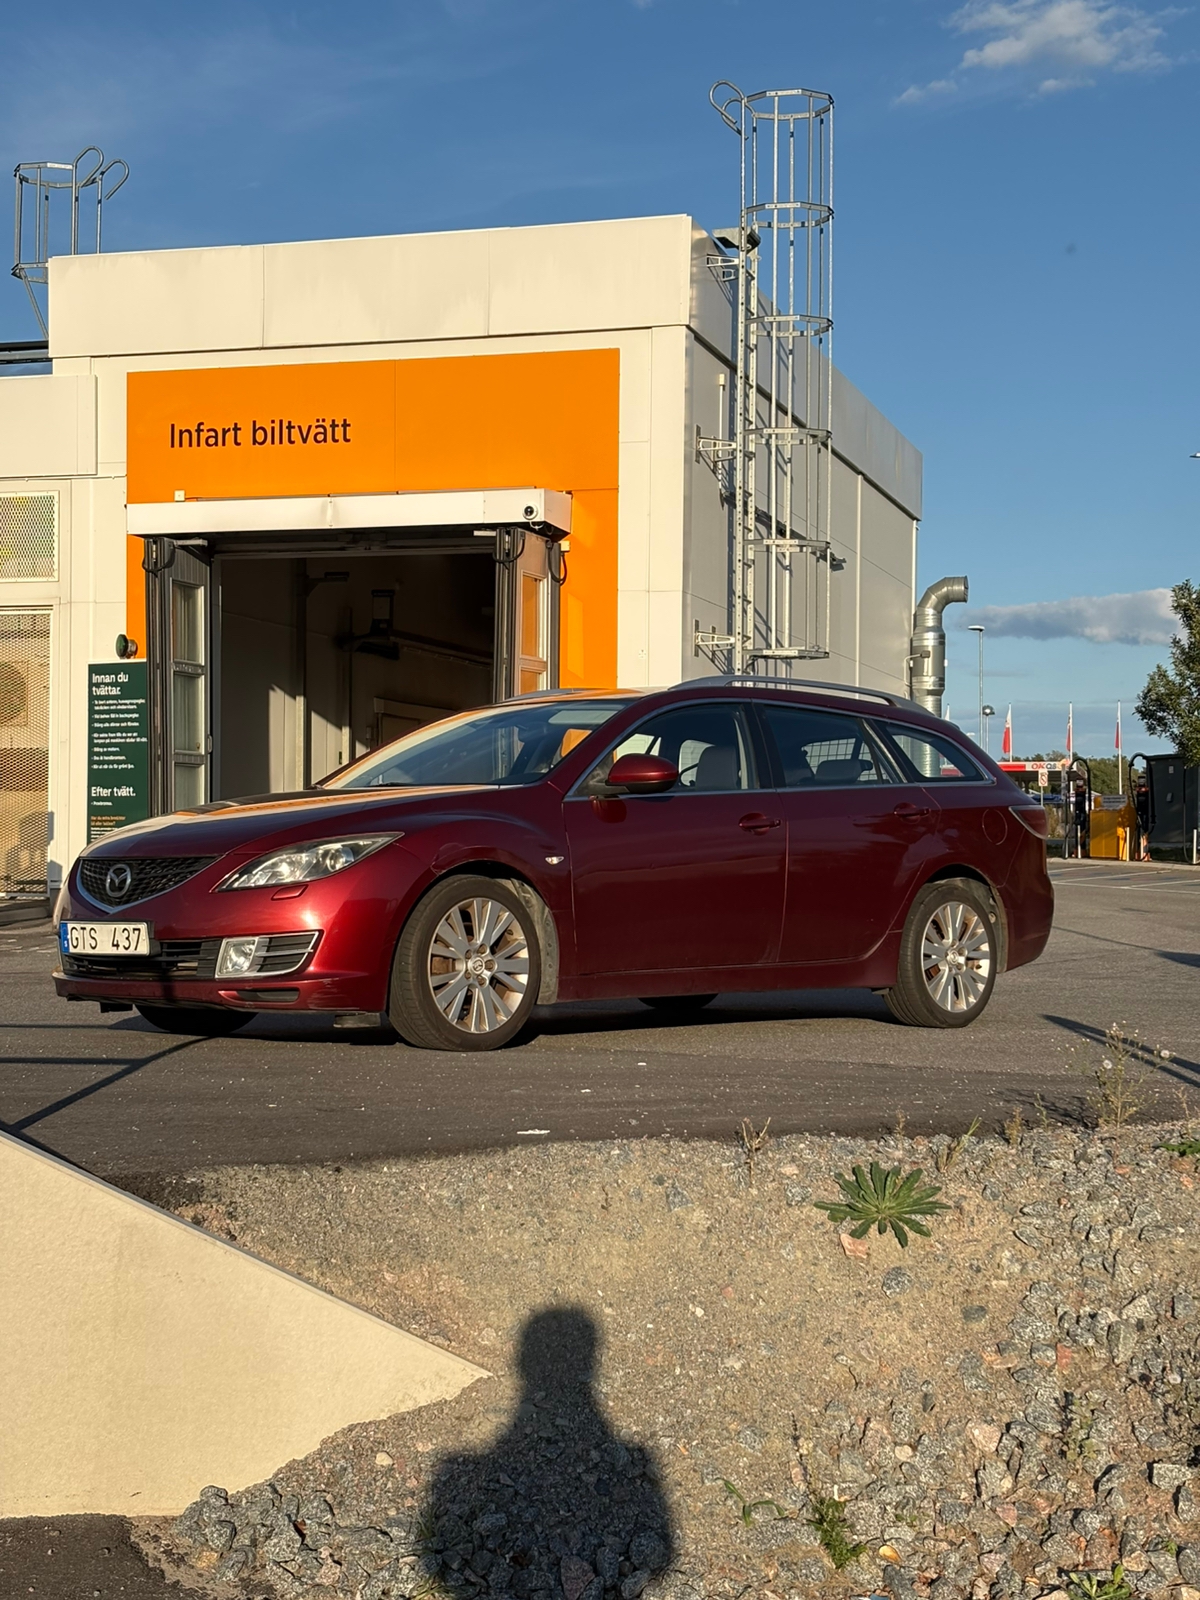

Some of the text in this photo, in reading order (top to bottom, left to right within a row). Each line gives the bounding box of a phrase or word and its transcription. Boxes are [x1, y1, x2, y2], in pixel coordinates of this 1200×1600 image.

[170, 417, 352, 449] Infart biltvätt
[92, 671, 129, 683] Innan du
[92, 684, 122, 696] tvättar.
[91, 785, 136, 797] Efter tvätt.
[70, 926, 142, 951] GTS 437
